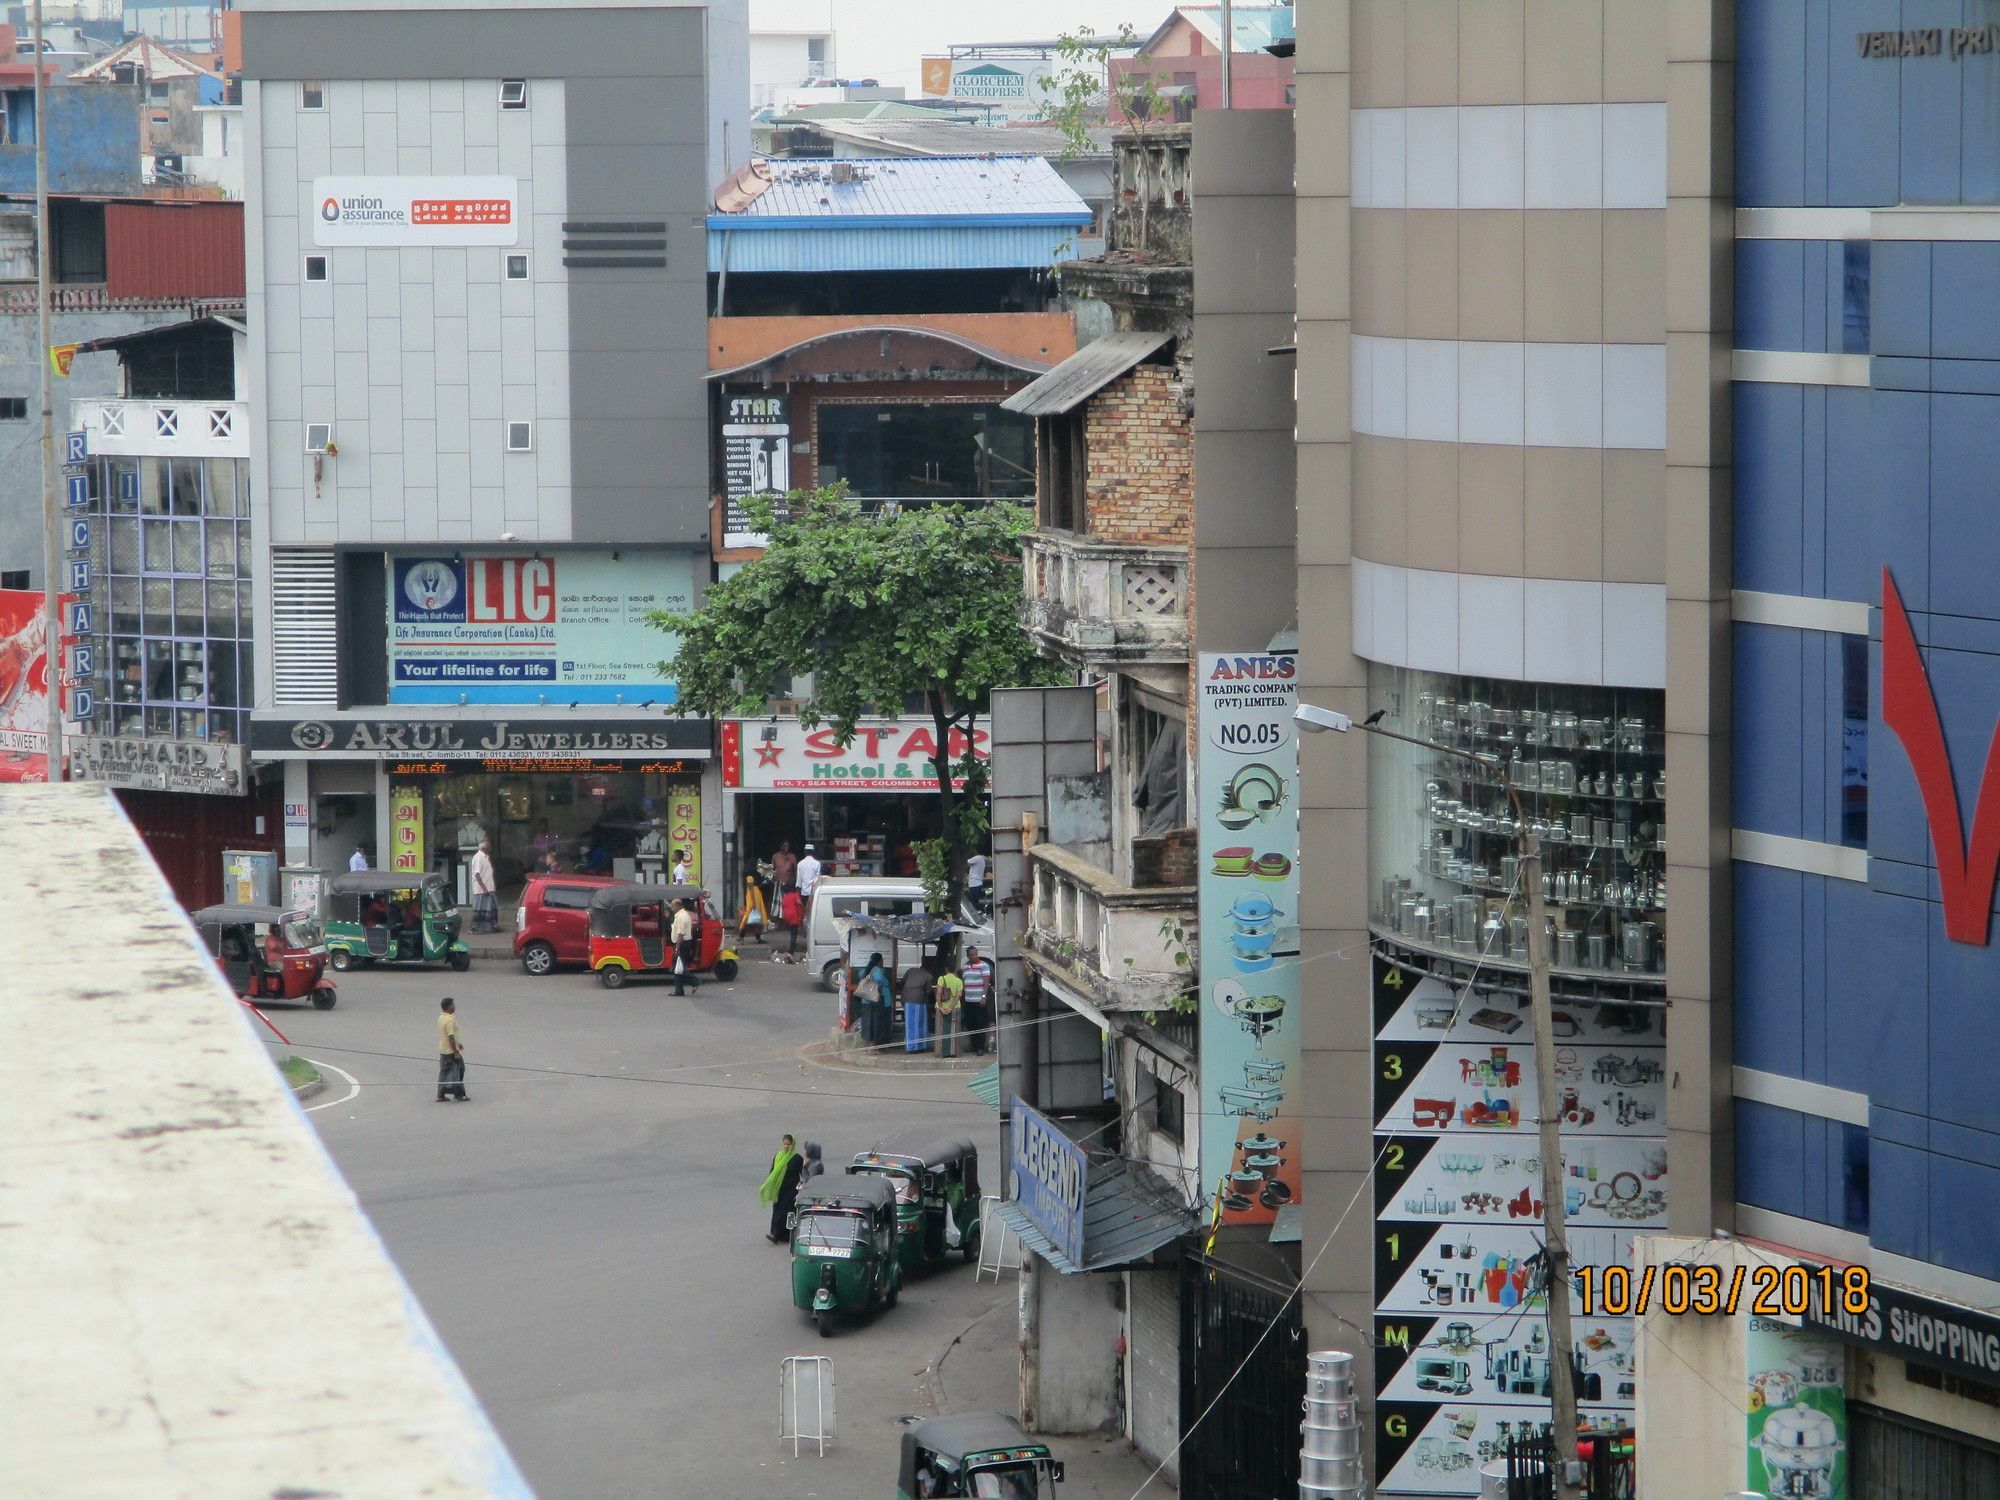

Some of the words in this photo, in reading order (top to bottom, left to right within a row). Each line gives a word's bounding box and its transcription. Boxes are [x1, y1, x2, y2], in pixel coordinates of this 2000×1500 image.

[1856, 28, 1942, 58] VEMAKI
[953, 75, 1024, 87] GLORCHEM
[953, 87, 1024, 97] ENTERPRISE
[342, 194, 382, 209] union
[342, 209, 404, 221] assurance
[730, 398, 781, 416] STAR
[67, 434, 92, 719] RICHARD
[473, 559, 551, 621] LIC
[395, 625, 409, 639] Life
[411, 625, 452, 638] Insurance
[454, 625, 503, 640] Corporation
[504, 624, 538, 641] (Lanka)
[540, 625, 556, 638] Ltd.
[403, 664, 438, 675] Your
[442, 664, 494, 676] lifeline
[499, 664, 520, 675] for
[524, 664, 549, 676] life
[1210, 656, 1296, 680] ANES
[1205, 684, 1250, 695] TRADING
[1214, 697, 1242, 709] (PVT)
[1244, 697, 1288, 707] LIMITED.
[11, 733, 38, 750] SWEET
[346, 721, 465, 750] ARUL
[480, 721, 668, 750] JEWELLERS
[803, 727, 991, 760] STAR
[1221, 723, 1280, 744] NO.05
[101, 739, 208, 765] RICHARD
[385, 751, 399, 759] Sea
[401, 751, 425, 759] Street,
[812, 762, 885, 779] Hotel
[893, 762, 914, 779] &
[295, 804, 308, 817] LIC
[1383, 966, 1404, 990] 4
[1383, 1054, 1403, 1080] 3
[1015, 1110, 1083, 1213] LEGEND
[1385, 1144, 1405, 1170] 2
[1385, 1233, 1400, 1262] 1
[1384, 1325, 1409, 1348] M
[1749, 1319, 1787, 1333] Best
[1889, 1305, 2000, 1373] SHOPPING
[1385, 1414, 1408, 1438] G
